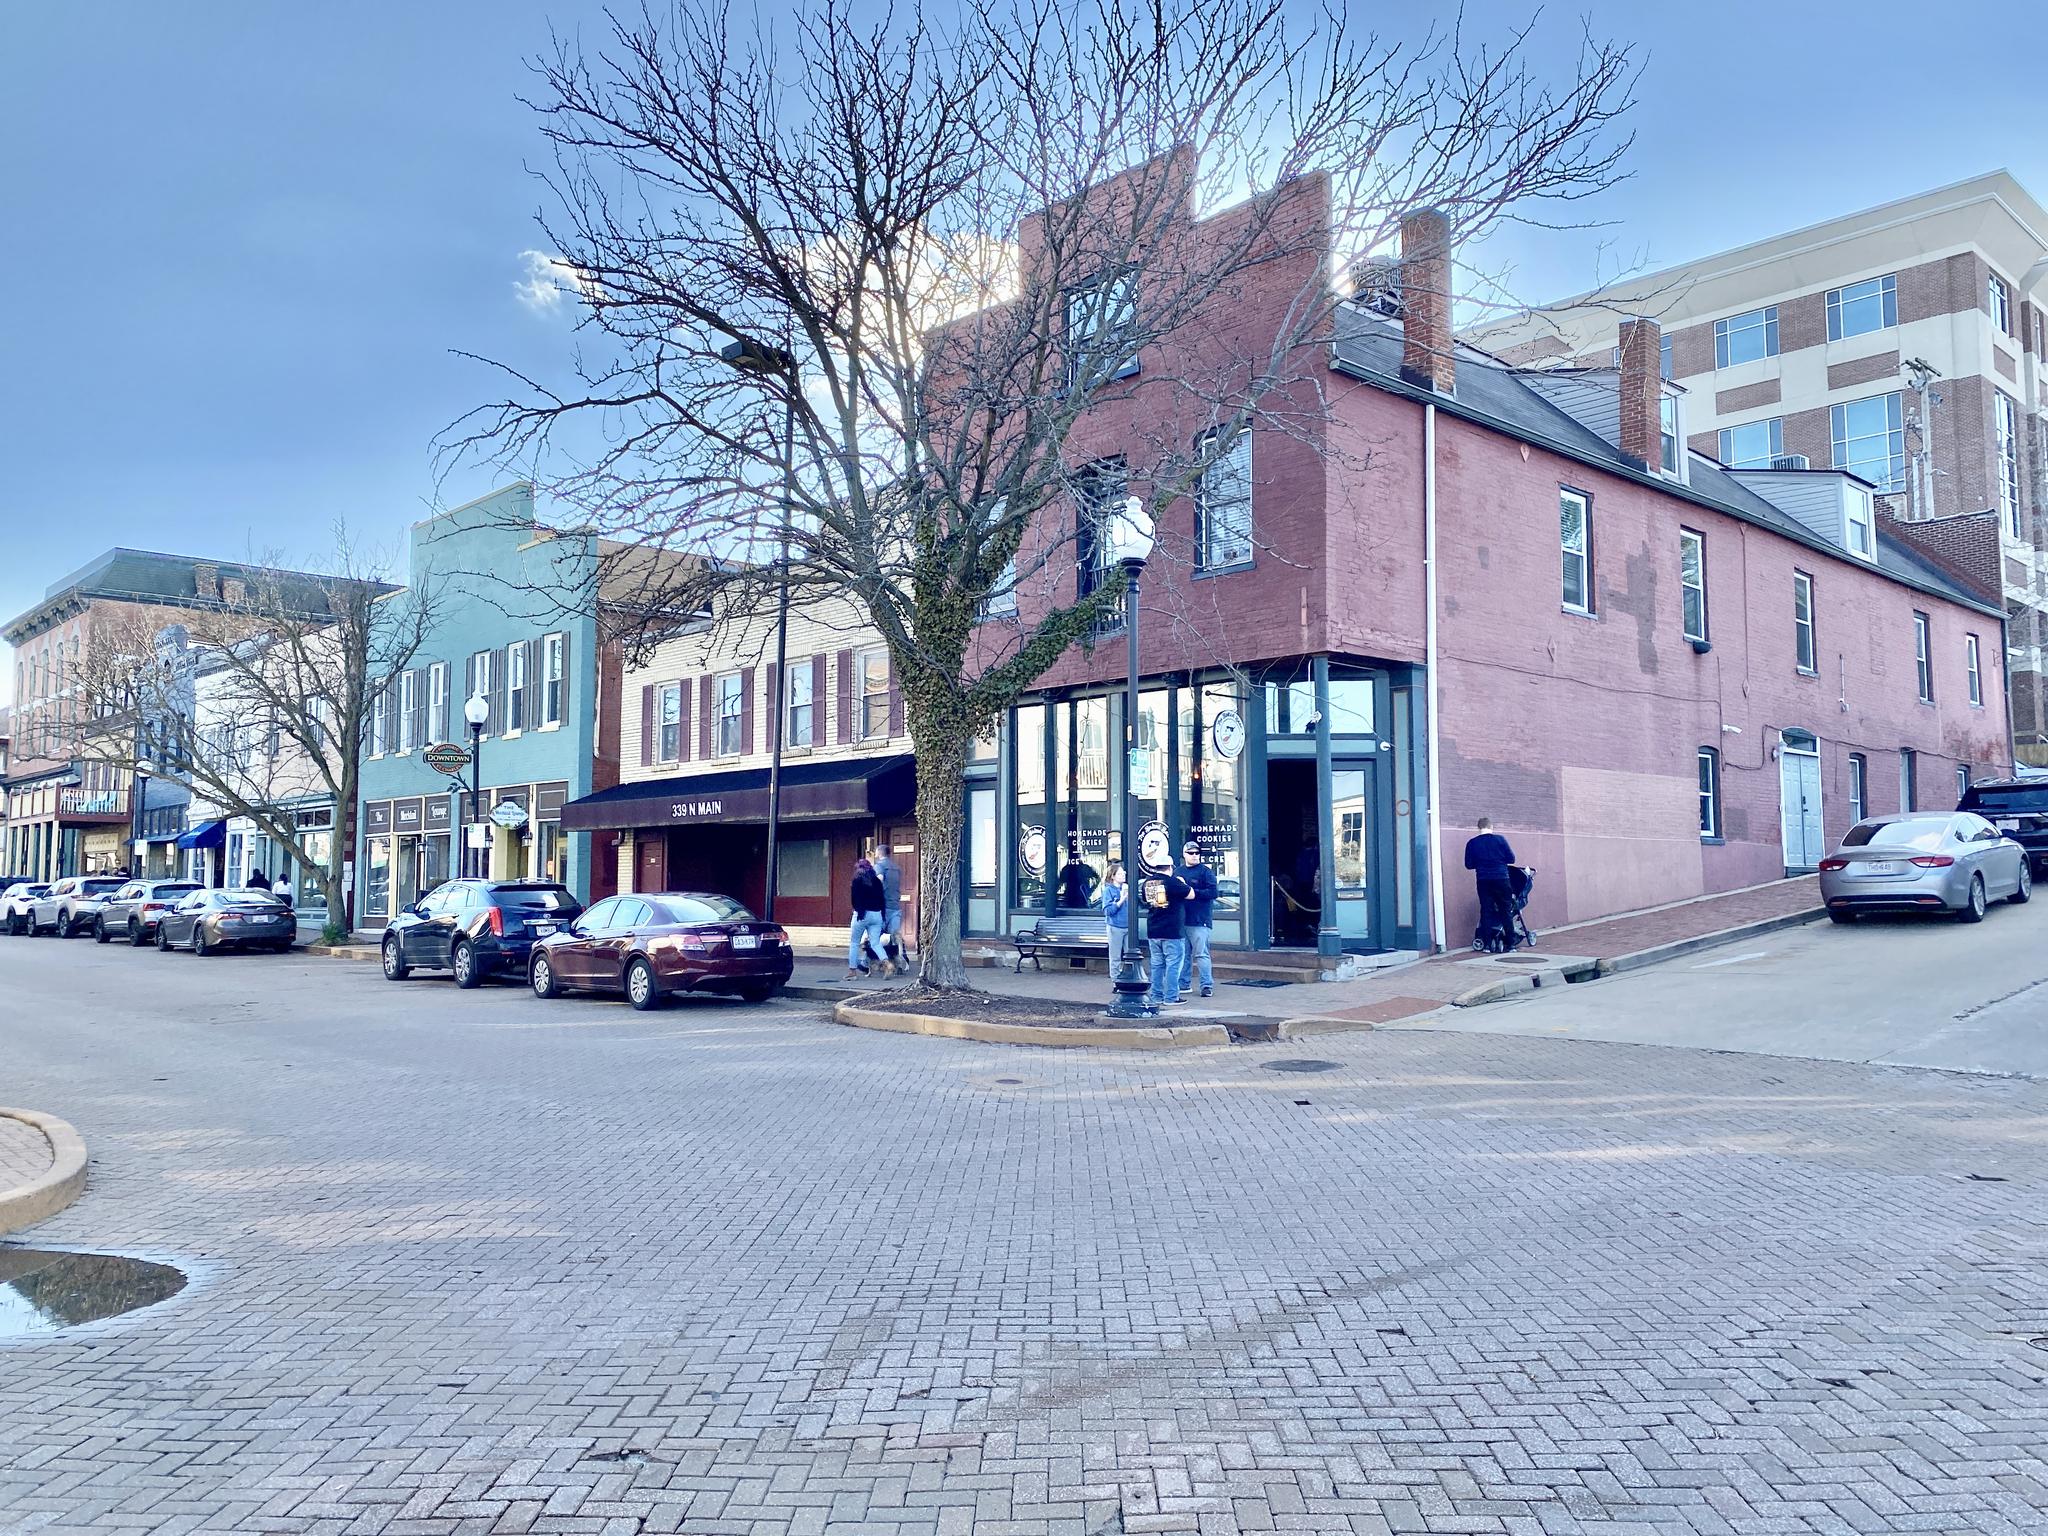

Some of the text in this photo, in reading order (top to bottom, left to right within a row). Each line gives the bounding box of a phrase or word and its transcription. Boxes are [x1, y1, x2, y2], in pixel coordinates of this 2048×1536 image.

[427, 754, 470, 762] DOWNTOWN
[672, 800, 722, 817] 339 N MAIN
[1067, 829, 1107, 837] HOMEMADE
[1191, 824, 1238, 833] HOMEMADE
[1196, 834, 1232, 843] COOKIES
